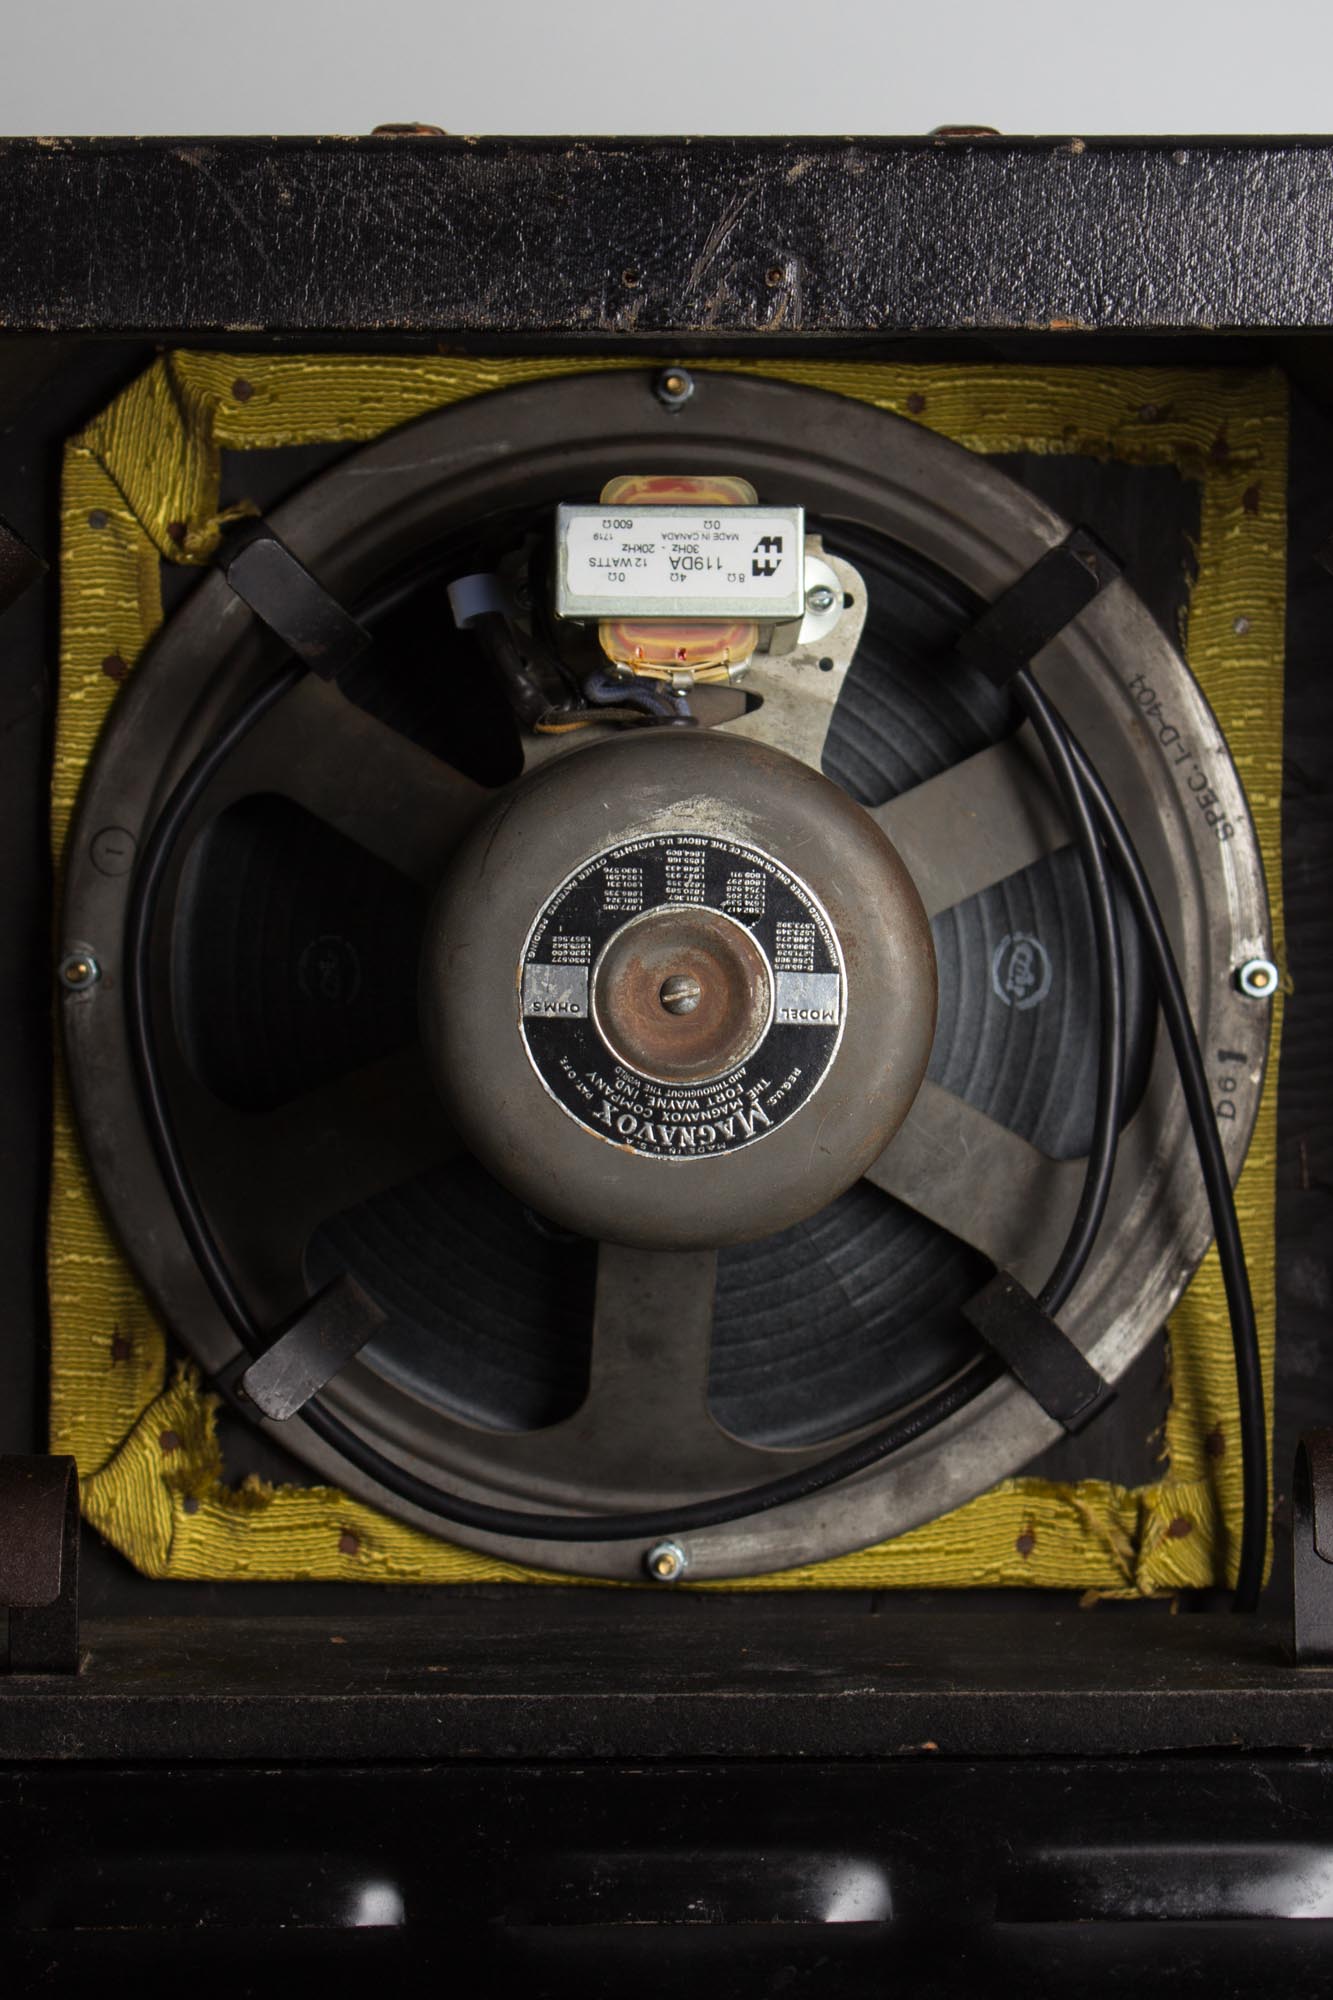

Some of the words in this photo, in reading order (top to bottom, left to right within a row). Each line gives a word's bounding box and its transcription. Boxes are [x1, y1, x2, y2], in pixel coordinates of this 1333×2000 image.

[593, 533, 613, 541] 1719
[661, 533, 699, 541] CANADA
[700, 533, 710, 541] IN
[712, 533, 739, 541] MADE
[622, 544, 655, 554] 20kHz
[672, 544, 700, 554] 30Hz
[588, 557, 633, 567] WATTS
[634, 557, 648, 567] 12
[669, 556, 723, 570] 119DA
[1188, 764, 1235, 841] SPEC.
[677, 837, 708, 846] ABOVE
[711, 840, 727, 851] THE
[610, 840, 655, 858] PATENTS.
[729, 844, 740, 854] OF
[741, 850, 764, 866] MORE
[577, 858, 607, 880] OTHER
[764, 862, 776, 873] OR
[775, 870, 791, 885] ONE
[547, 880, 578, 915] PATENTS
[790, 883, 811, 907] UNDER
[809, 907, 839, 966] MANUFACTURED
[532, 1001, 579, 1013] OHMS
[780, 1008, 834, 1022] MODEL
[614, 1066, 640, 1088] WORLD
[728, 1067, 746, 1083] AND
[586, 1072, 653, 1118] COMPANY
[615, 1077, 639, 1099] IND.
[643, 1084, 661, 1095] THE
[665, 1081, 729, 1098] THROUGHOUT
[707, 1083, 744, 1106] FORT
[746, 1079, 771, 1099] THE
[662, 1097, 743, 1121] MAGNAVOX
[593, 1098, 774, 1146] MAGNAVOX
[689, 1142, 726, 1153] MADE
